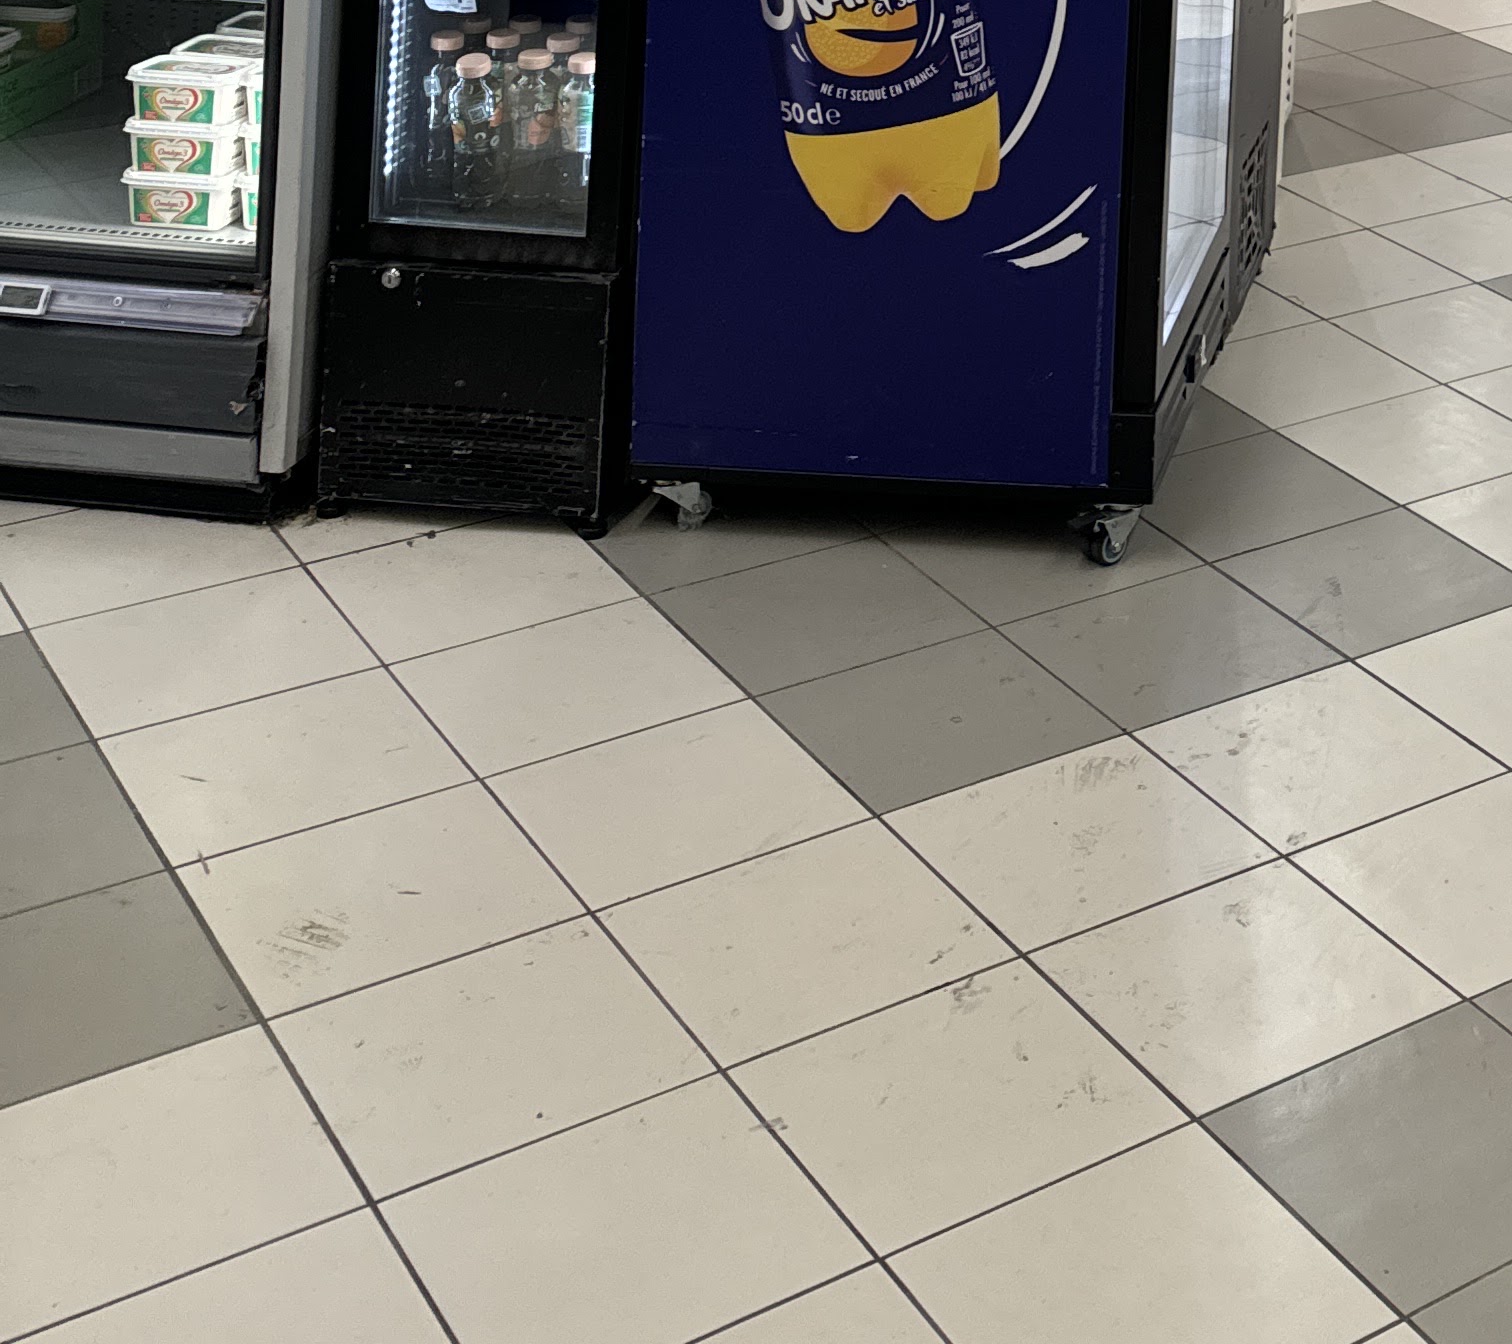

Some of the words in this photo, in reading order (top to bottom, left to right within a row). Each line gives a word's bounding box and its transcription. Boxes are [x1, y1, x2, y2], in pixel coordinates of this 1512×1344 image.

[820, 81, 834, 97] NÉ
[836, 88, 849, 100] ET
[850, 85, 888, 102] SECOUÉ
[889, 83, 903, 97] EN
[903, 63, 940, 91] FRANCE
